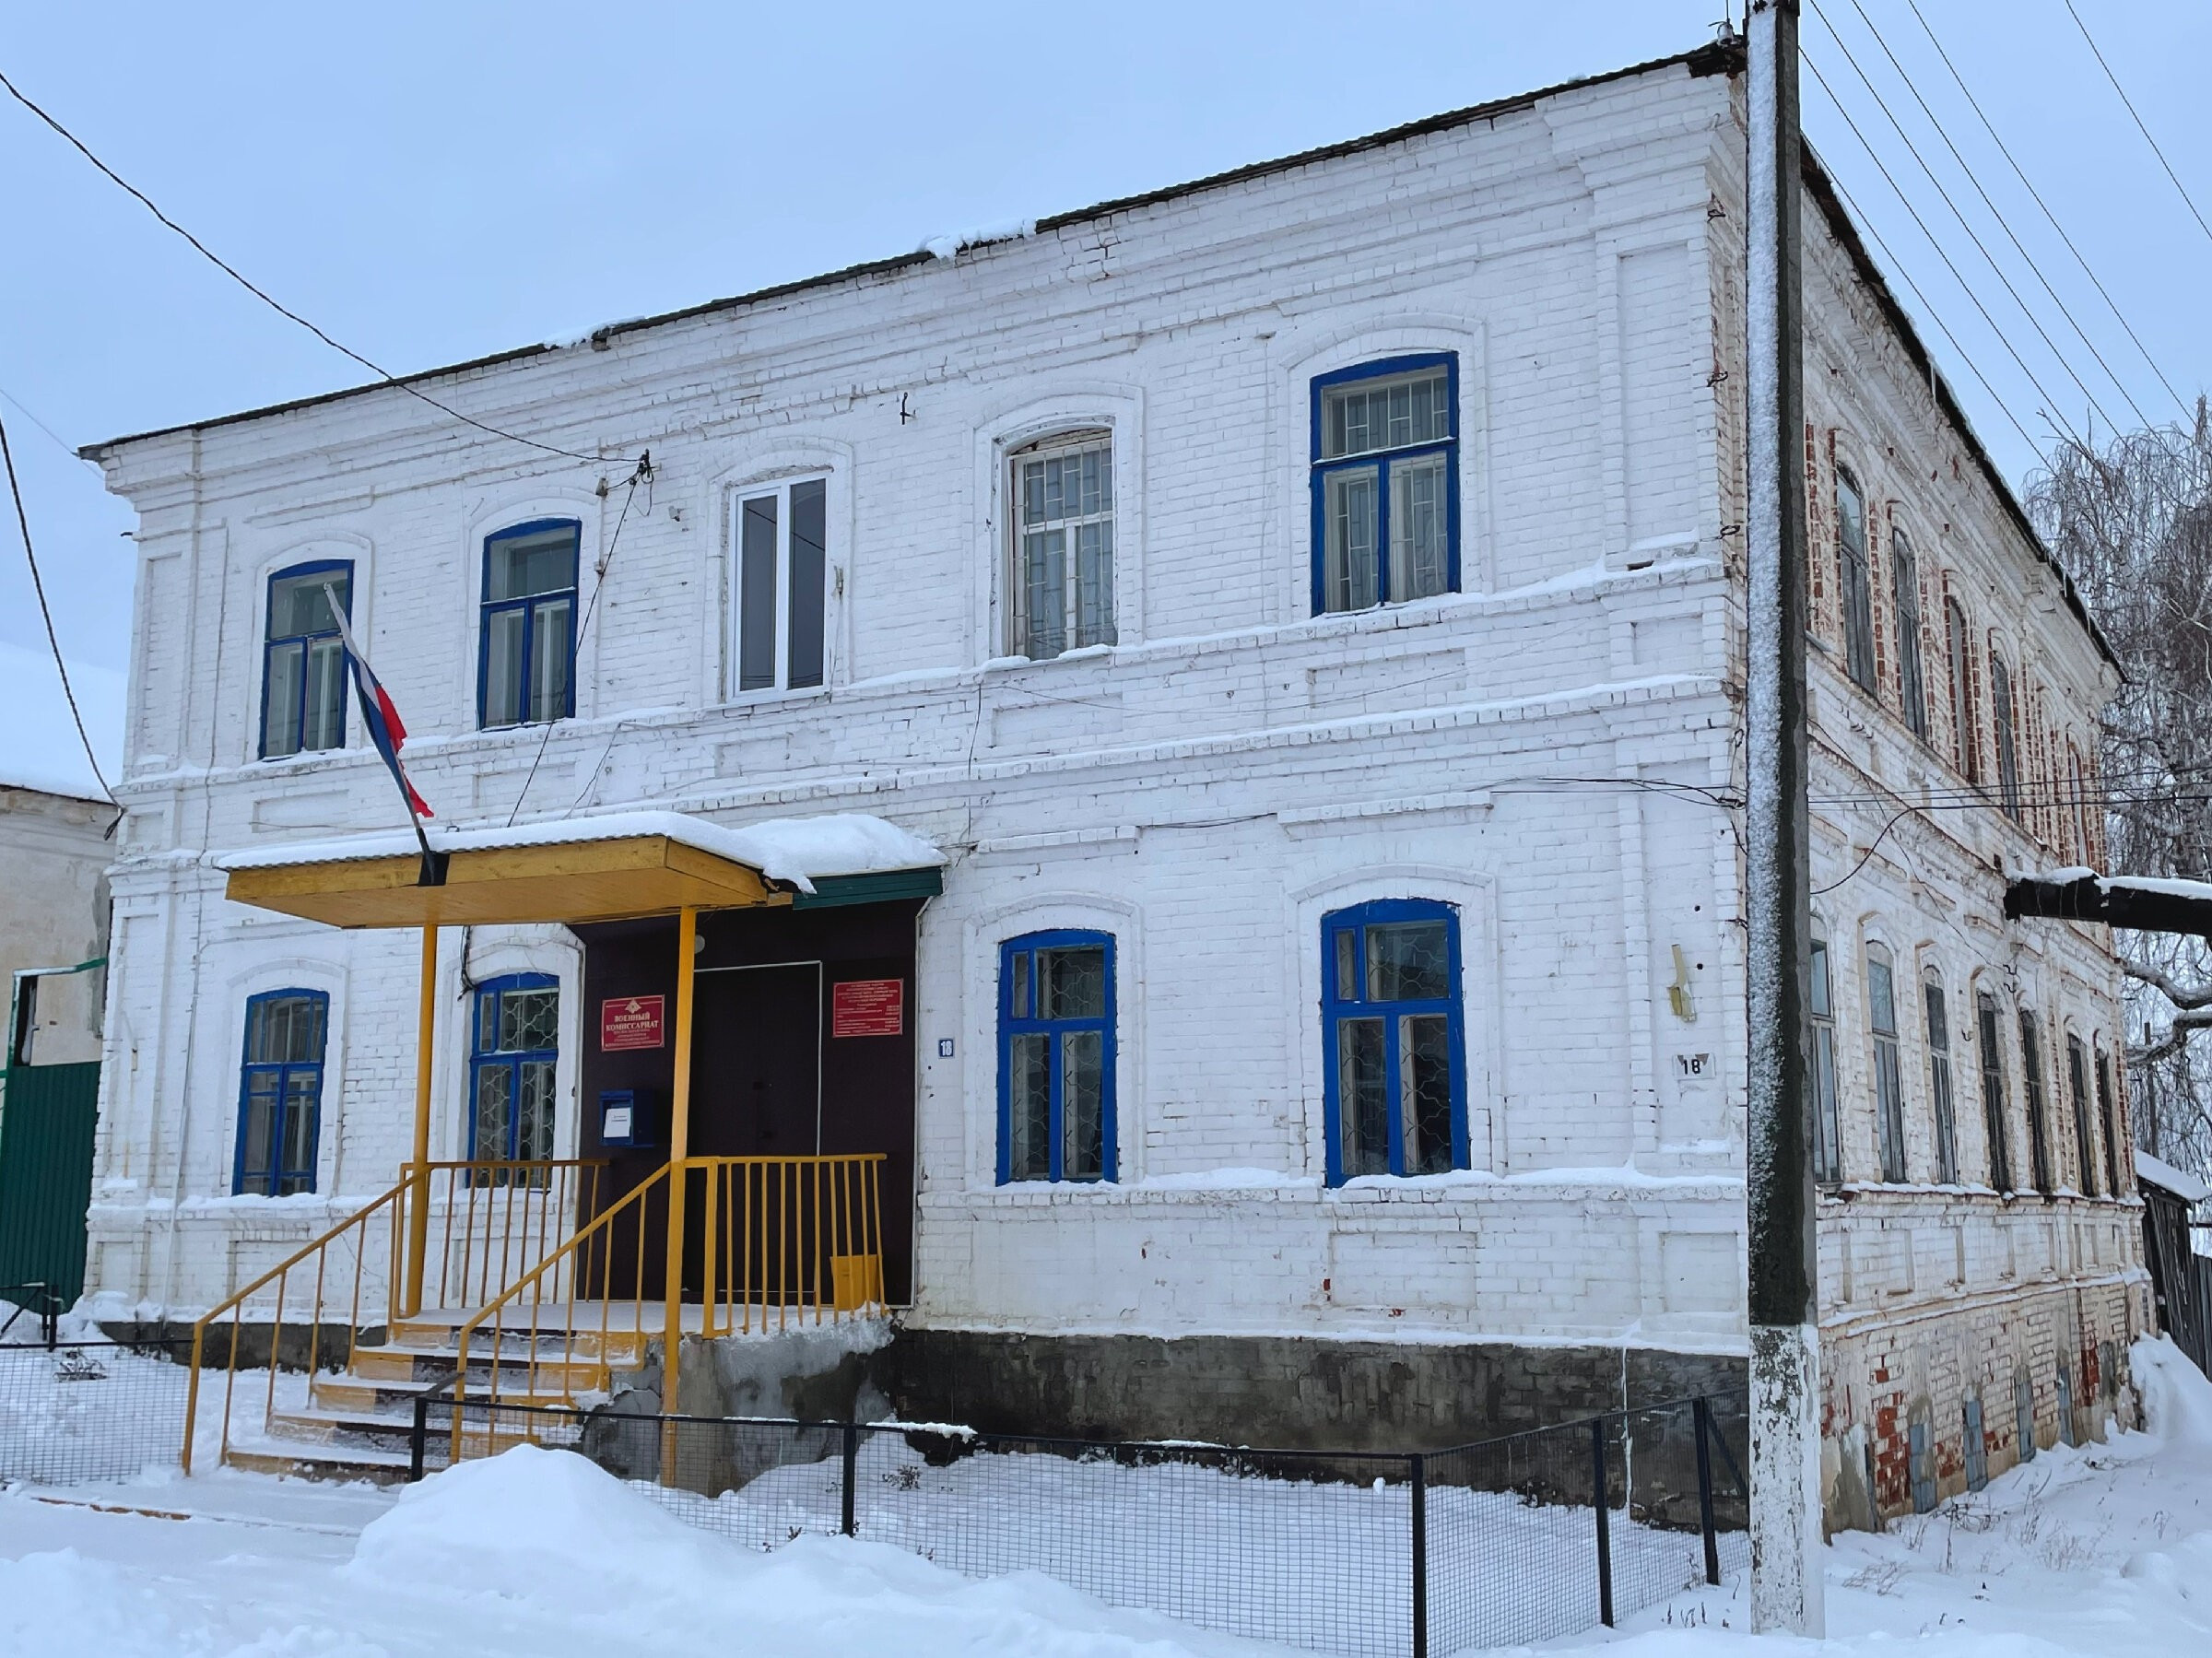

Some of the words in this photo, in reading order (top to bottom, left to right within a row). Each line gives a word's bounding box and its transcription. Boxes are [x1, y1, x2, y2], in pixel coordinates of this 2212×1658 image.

[614, 1012, 651, 1022] ВОЕННЫЙ
[606, 1020, 659, 1031] КОМИССАРИАТ
[940, 1041, 953, 1056] 18
[1683, 1059, 1700, 1075] 18
